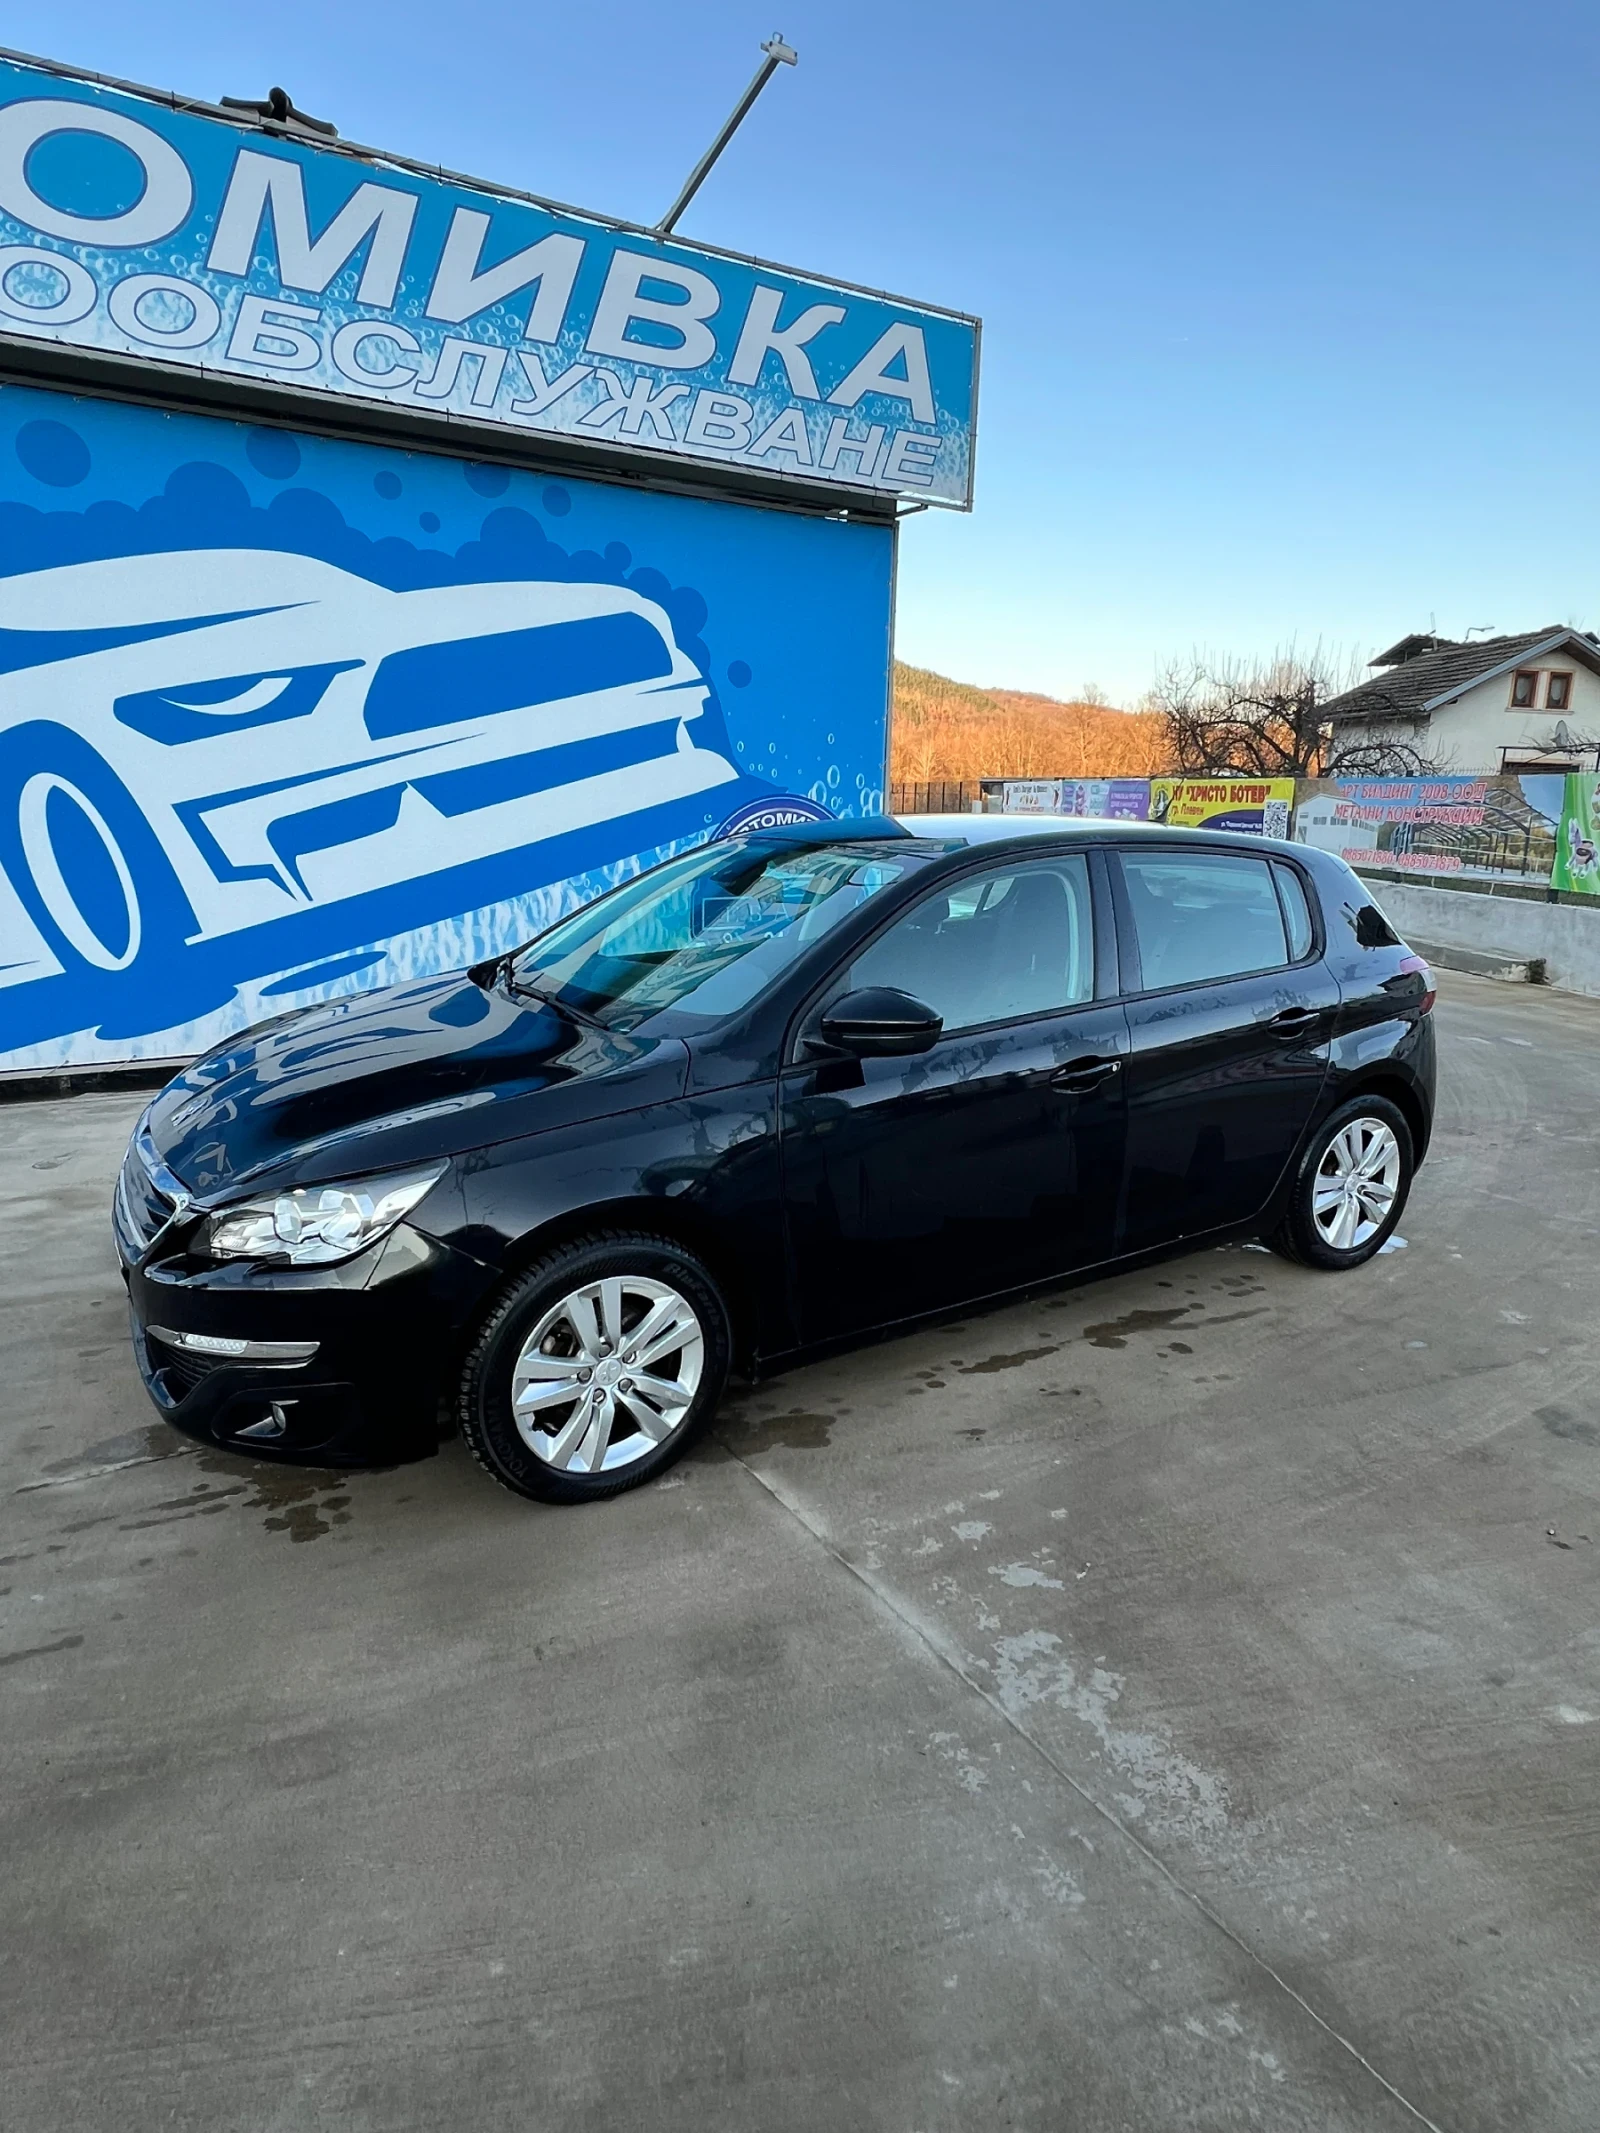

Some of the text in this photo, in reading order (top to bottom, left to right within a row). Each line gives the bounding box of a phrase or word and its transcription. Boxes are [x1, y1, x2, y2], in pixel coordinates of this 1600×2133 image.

[1361, 783, 1417, 799] БИЛДИНГ
[1334, 804, 1485, 825] МЕТАЛНИ КОНСТРУКЦИИ
